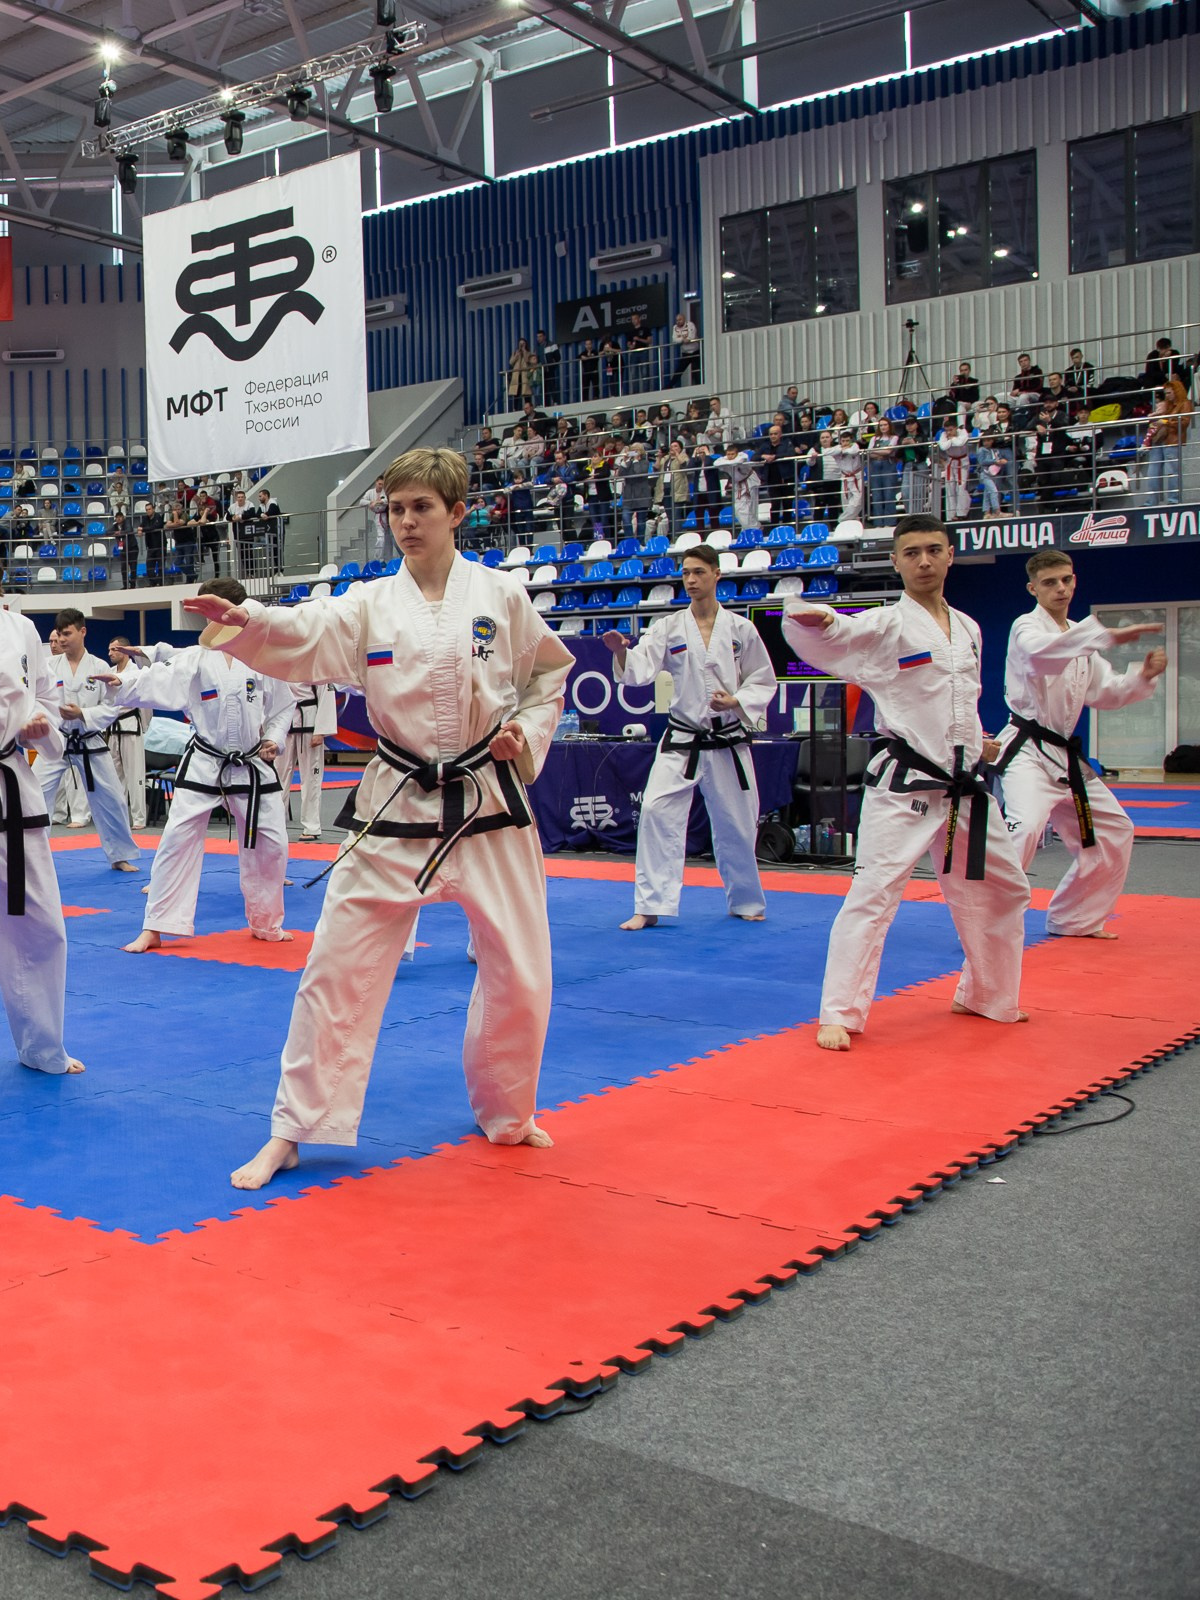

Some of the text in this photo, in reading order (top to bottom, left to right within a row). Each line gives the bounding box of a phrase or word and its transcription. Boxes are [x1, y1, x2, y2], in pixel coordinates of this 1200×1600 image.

[572, 301, 613, 333] A1
[615, 304, 648, 316] СЕКТОР
[244, 369, 329, 396] Федерация
[166, 386, 229, 421] МФТ
[244, 390, 323, 416] Тхэквондо
[245, 415, 300, 435] России
[955, 521, 1055, 551] ТУЛИЦА
[1143, 511, 1200, 538] ТУЛ
